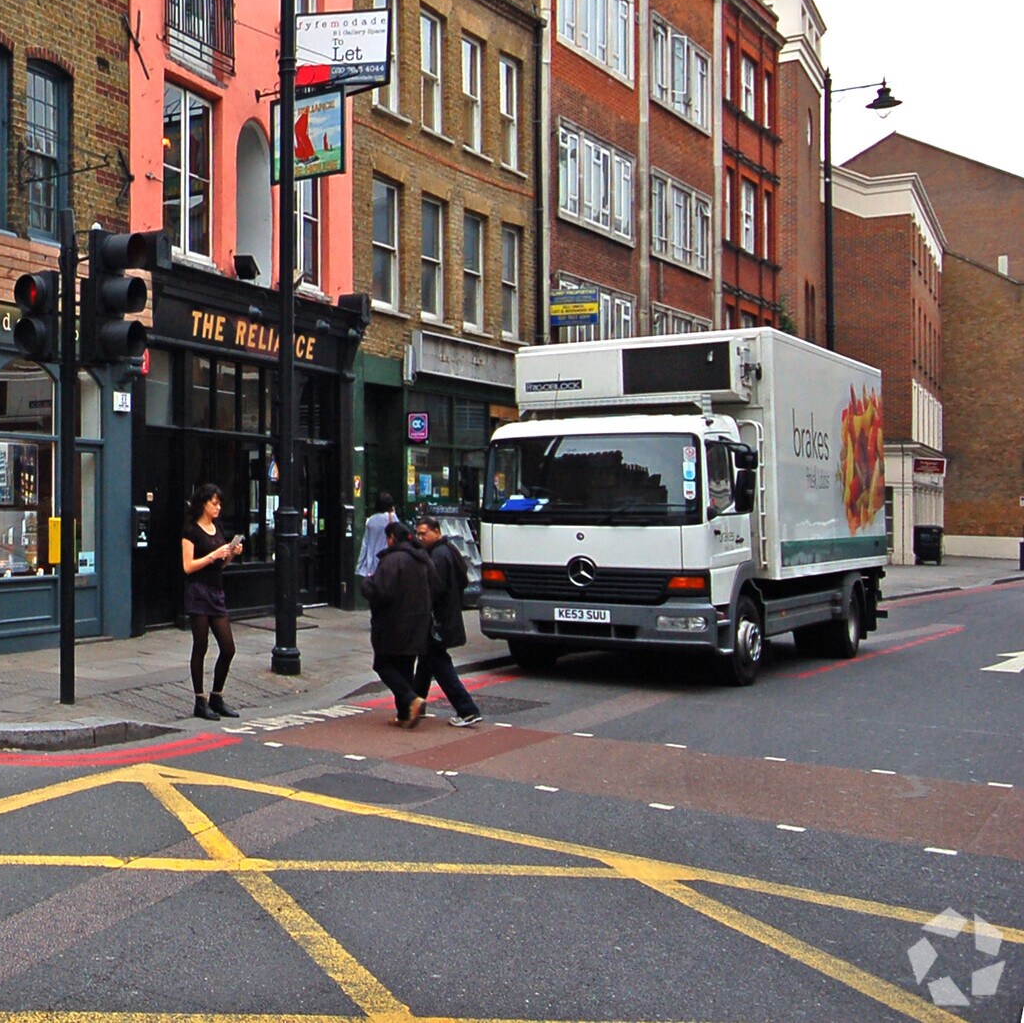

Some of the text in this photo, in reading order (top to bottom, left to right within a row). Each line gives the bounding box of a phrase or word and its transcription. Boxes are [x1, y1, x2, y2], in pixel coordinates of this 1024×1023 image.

[332, 38, 344, 46] To
[331, 46, 363, 62] Let
[192, 310, 316, 360] THE RELICE
[792, 407, 830, 461] brakes
[558, 609, 606, 620] KE53 SUU
